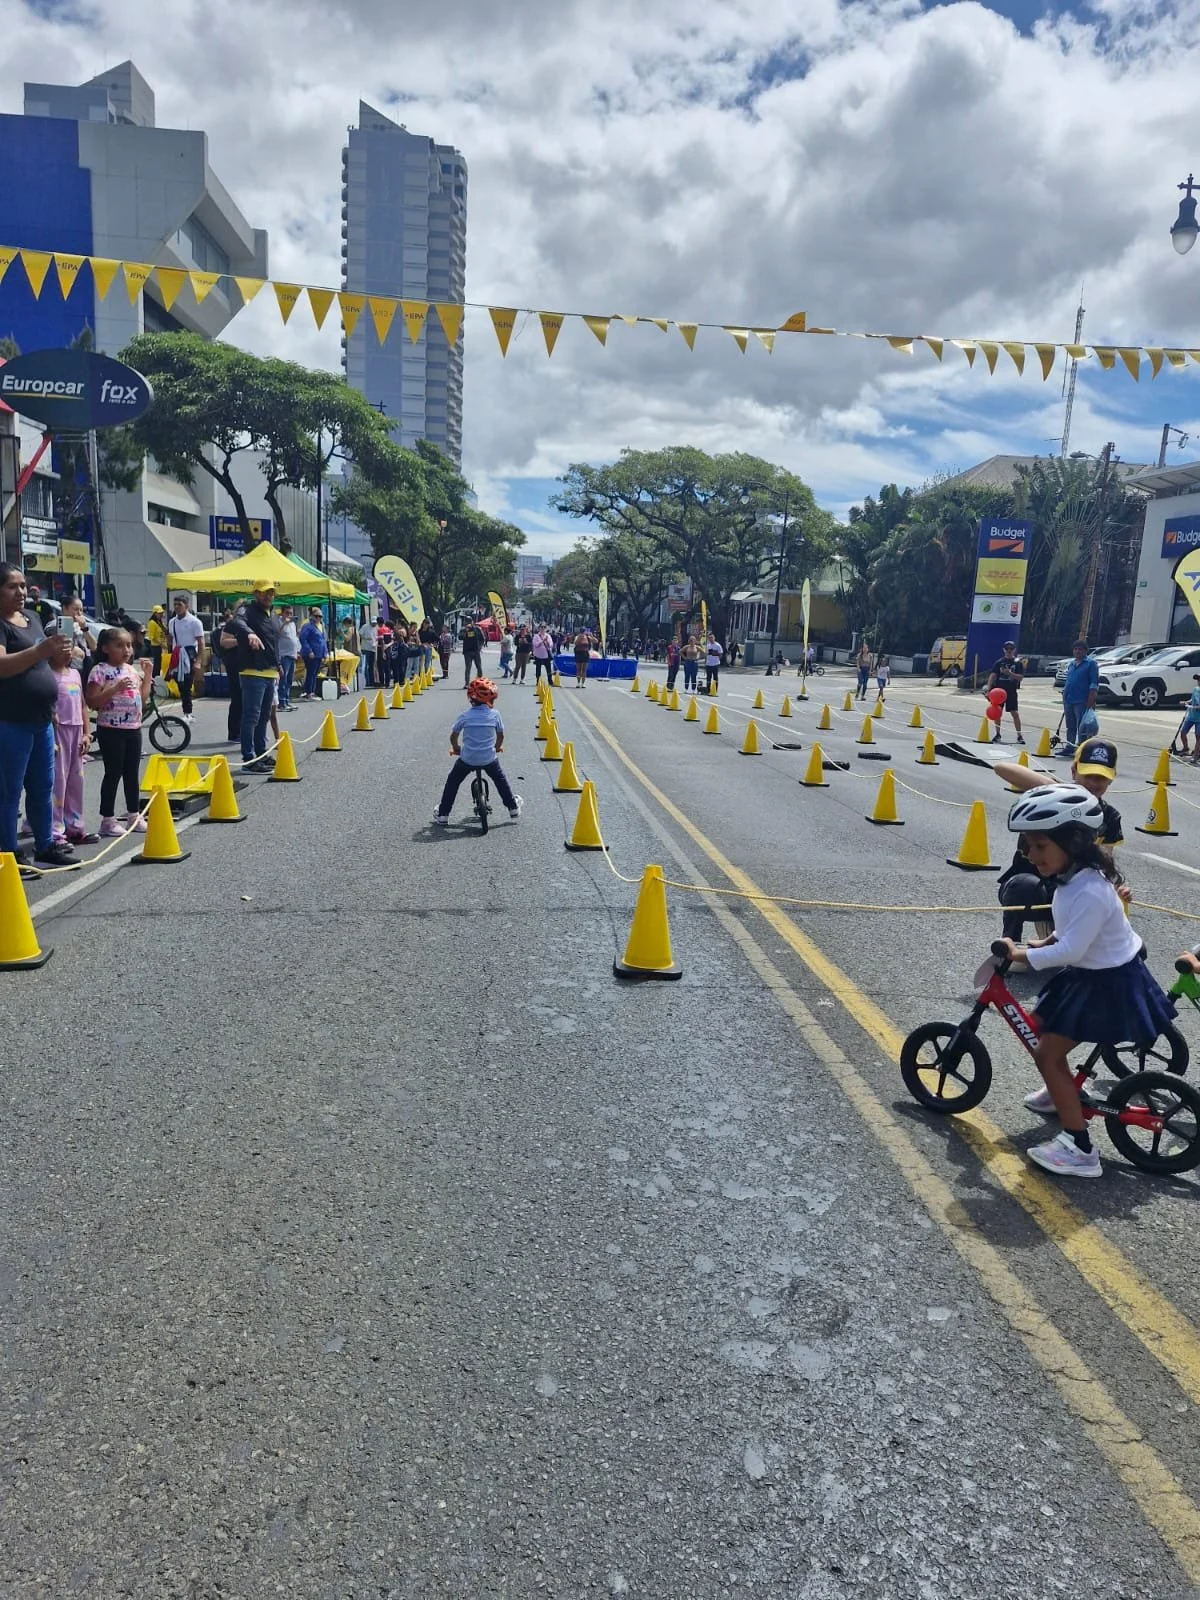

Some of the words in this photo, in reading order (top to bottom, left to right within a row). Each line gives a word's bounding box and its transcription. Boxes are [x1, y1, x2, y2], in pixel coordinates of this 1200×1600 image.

[2, 375, 85, 397] Europcar
[101, 379, 139, 403] fox
[990, 526, 1026, 540] Budget
